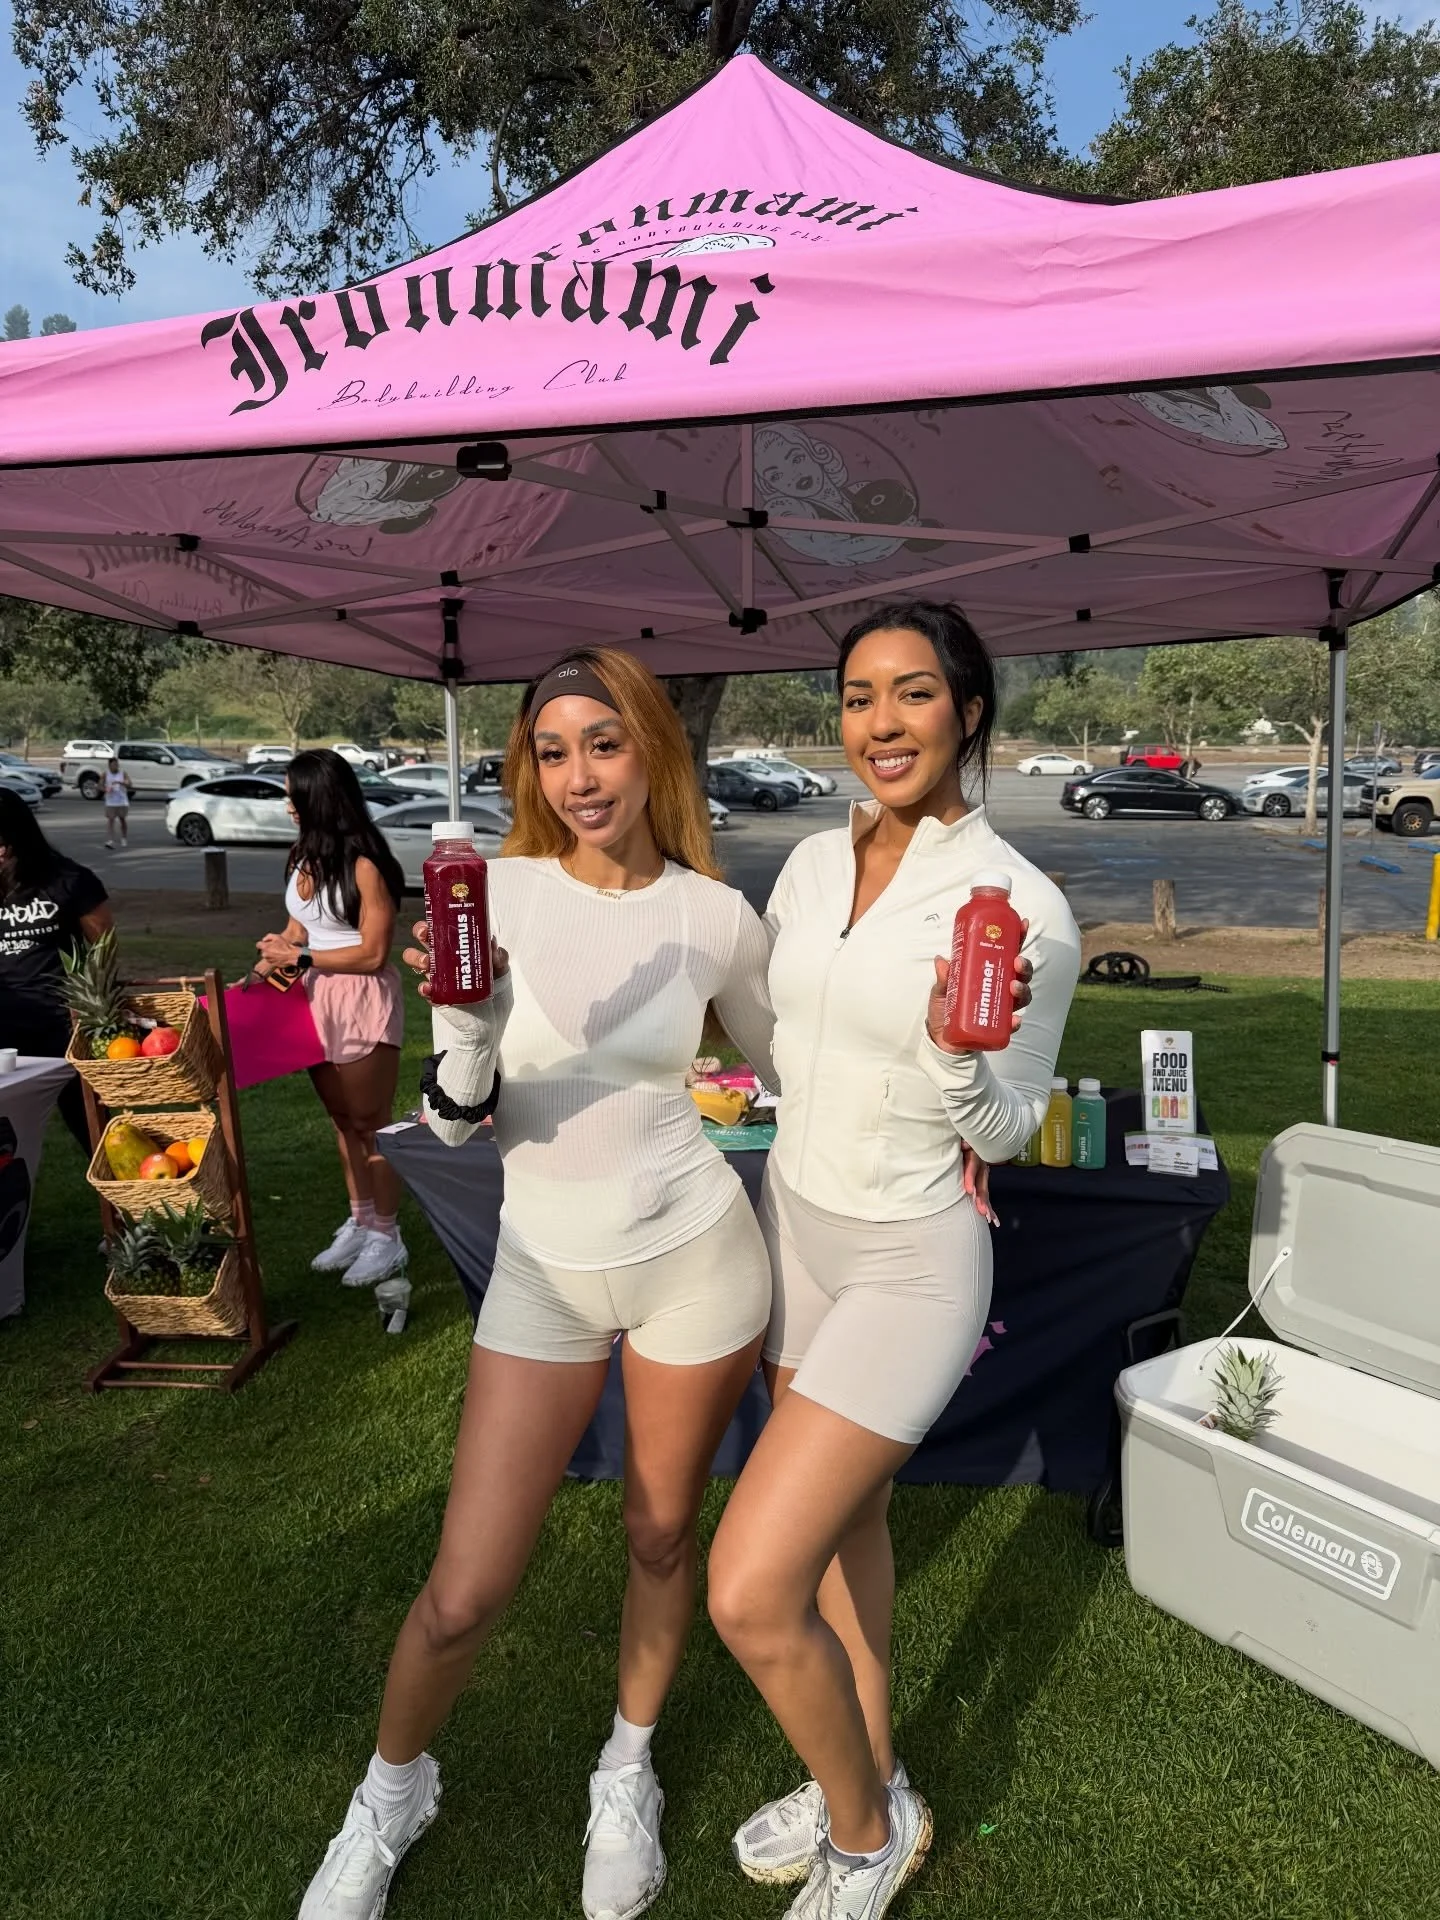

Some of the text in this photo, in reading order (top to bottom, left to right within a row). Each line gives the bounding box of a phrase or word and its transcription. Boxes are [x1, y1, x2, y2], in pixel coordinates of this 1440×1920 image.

[317, 359, 627, 411] Bodybuilding Club
[558, 667, 579, 678] alo
[4, 924, 59, 938] NUTRITION
[456, 913, 472, 990] maximus
[979, 960, 995, 1027] summer
[1152, 1052, 1187, 1069] FOOD
[1152, 1068, 1187, 1078] AND JUICE
[1152, 1078, 1187, 1092] MENU
[1078, 1136, 1088, 1163] laguna
[1257, 1501, 1356, 1568] Coleman
